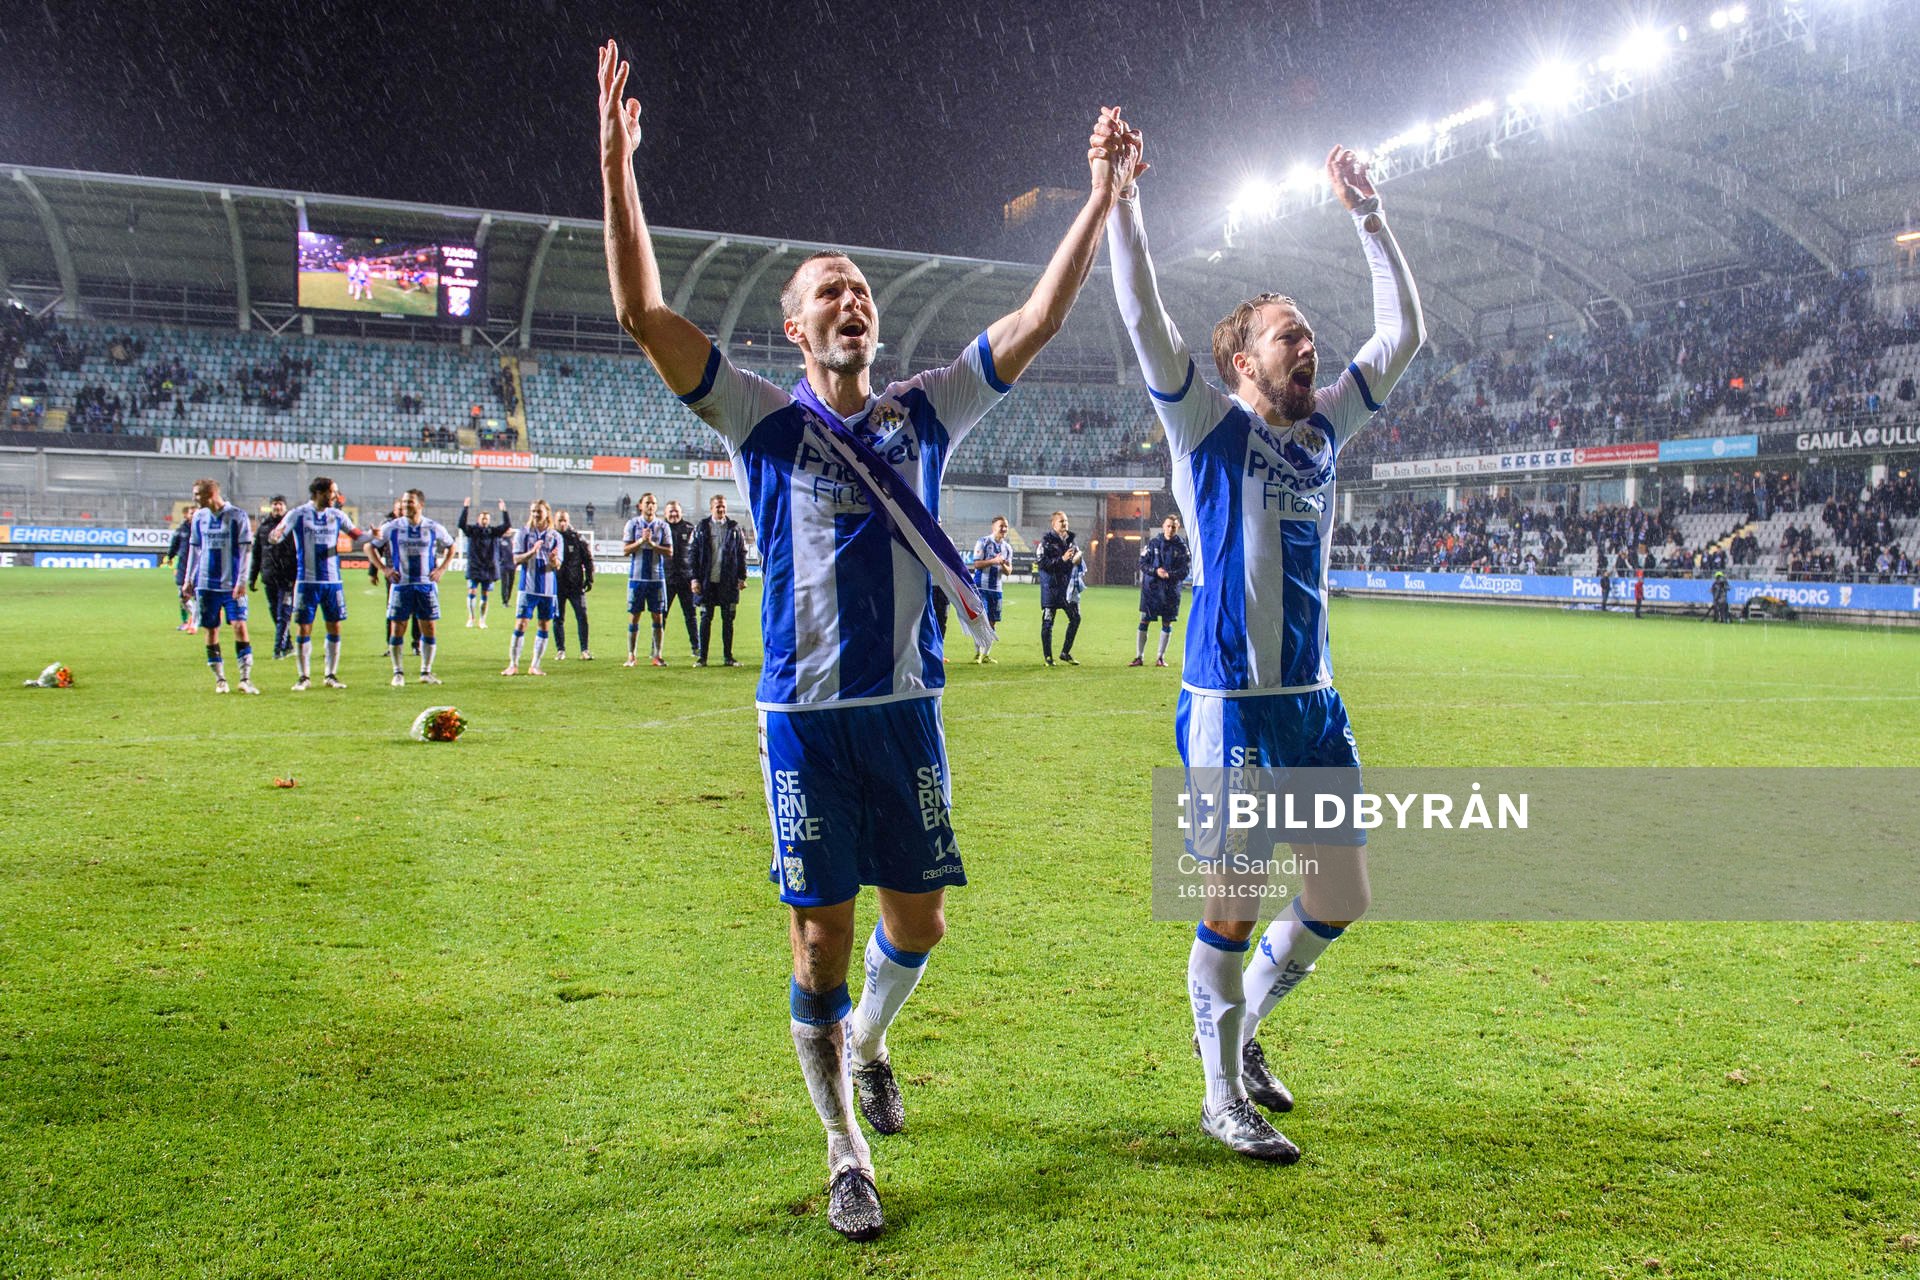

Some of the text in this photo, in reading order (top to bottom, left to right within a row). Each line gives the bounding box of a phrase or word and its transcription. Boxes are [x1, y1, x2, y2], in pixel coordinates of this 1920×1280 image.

[160, 438, 211, 456] ANTA
[214, 439, 334, 460] UTMANINGEN
[1796, 426, 1920, 451] GAMLA ULL
[375, 449, 594, 471] www.ulleviarenachallenge.se
[629, 458, 665, 475] 5km
[688, 461, 709, 477] 60
[12, 528, 125, 544] EHRENBORG
[1475, 575, 1522, 593] Kappa
[1230, 746, 1258, 769] SE
[775, 769, 801, 794] SE
[916, 763, 943, 789] SE
[1229, 768, 1260, 790] RN
[777, 794, 807, 817] RN
[779, 817, 822, 841] EKE
[934, 834, 960, 862] 14
[1193, 980, 1215, 1039] SKF
